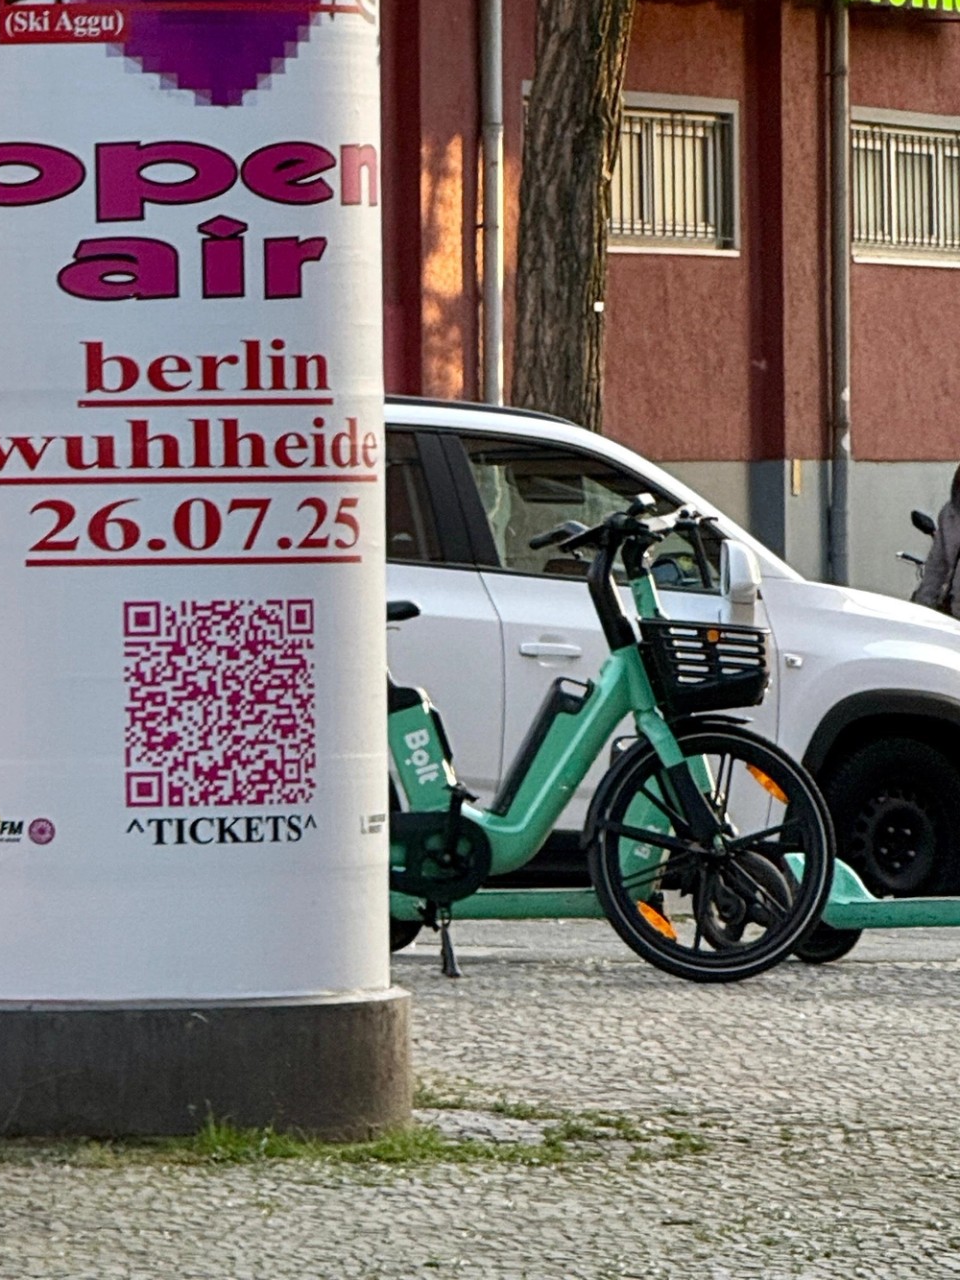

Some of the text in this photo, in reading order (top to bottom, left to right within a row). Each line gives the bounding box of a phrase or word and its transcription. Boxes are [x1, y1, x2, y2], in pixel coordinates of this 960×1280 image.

[5, 9, 124, 38] (Ski Aggu)
[57, 214, 328, 301] air
[78, 338, 332, 394] berlin
[28, 496, 362, 553] 26.07.25
[403, 727, 439, 785] Bolt
